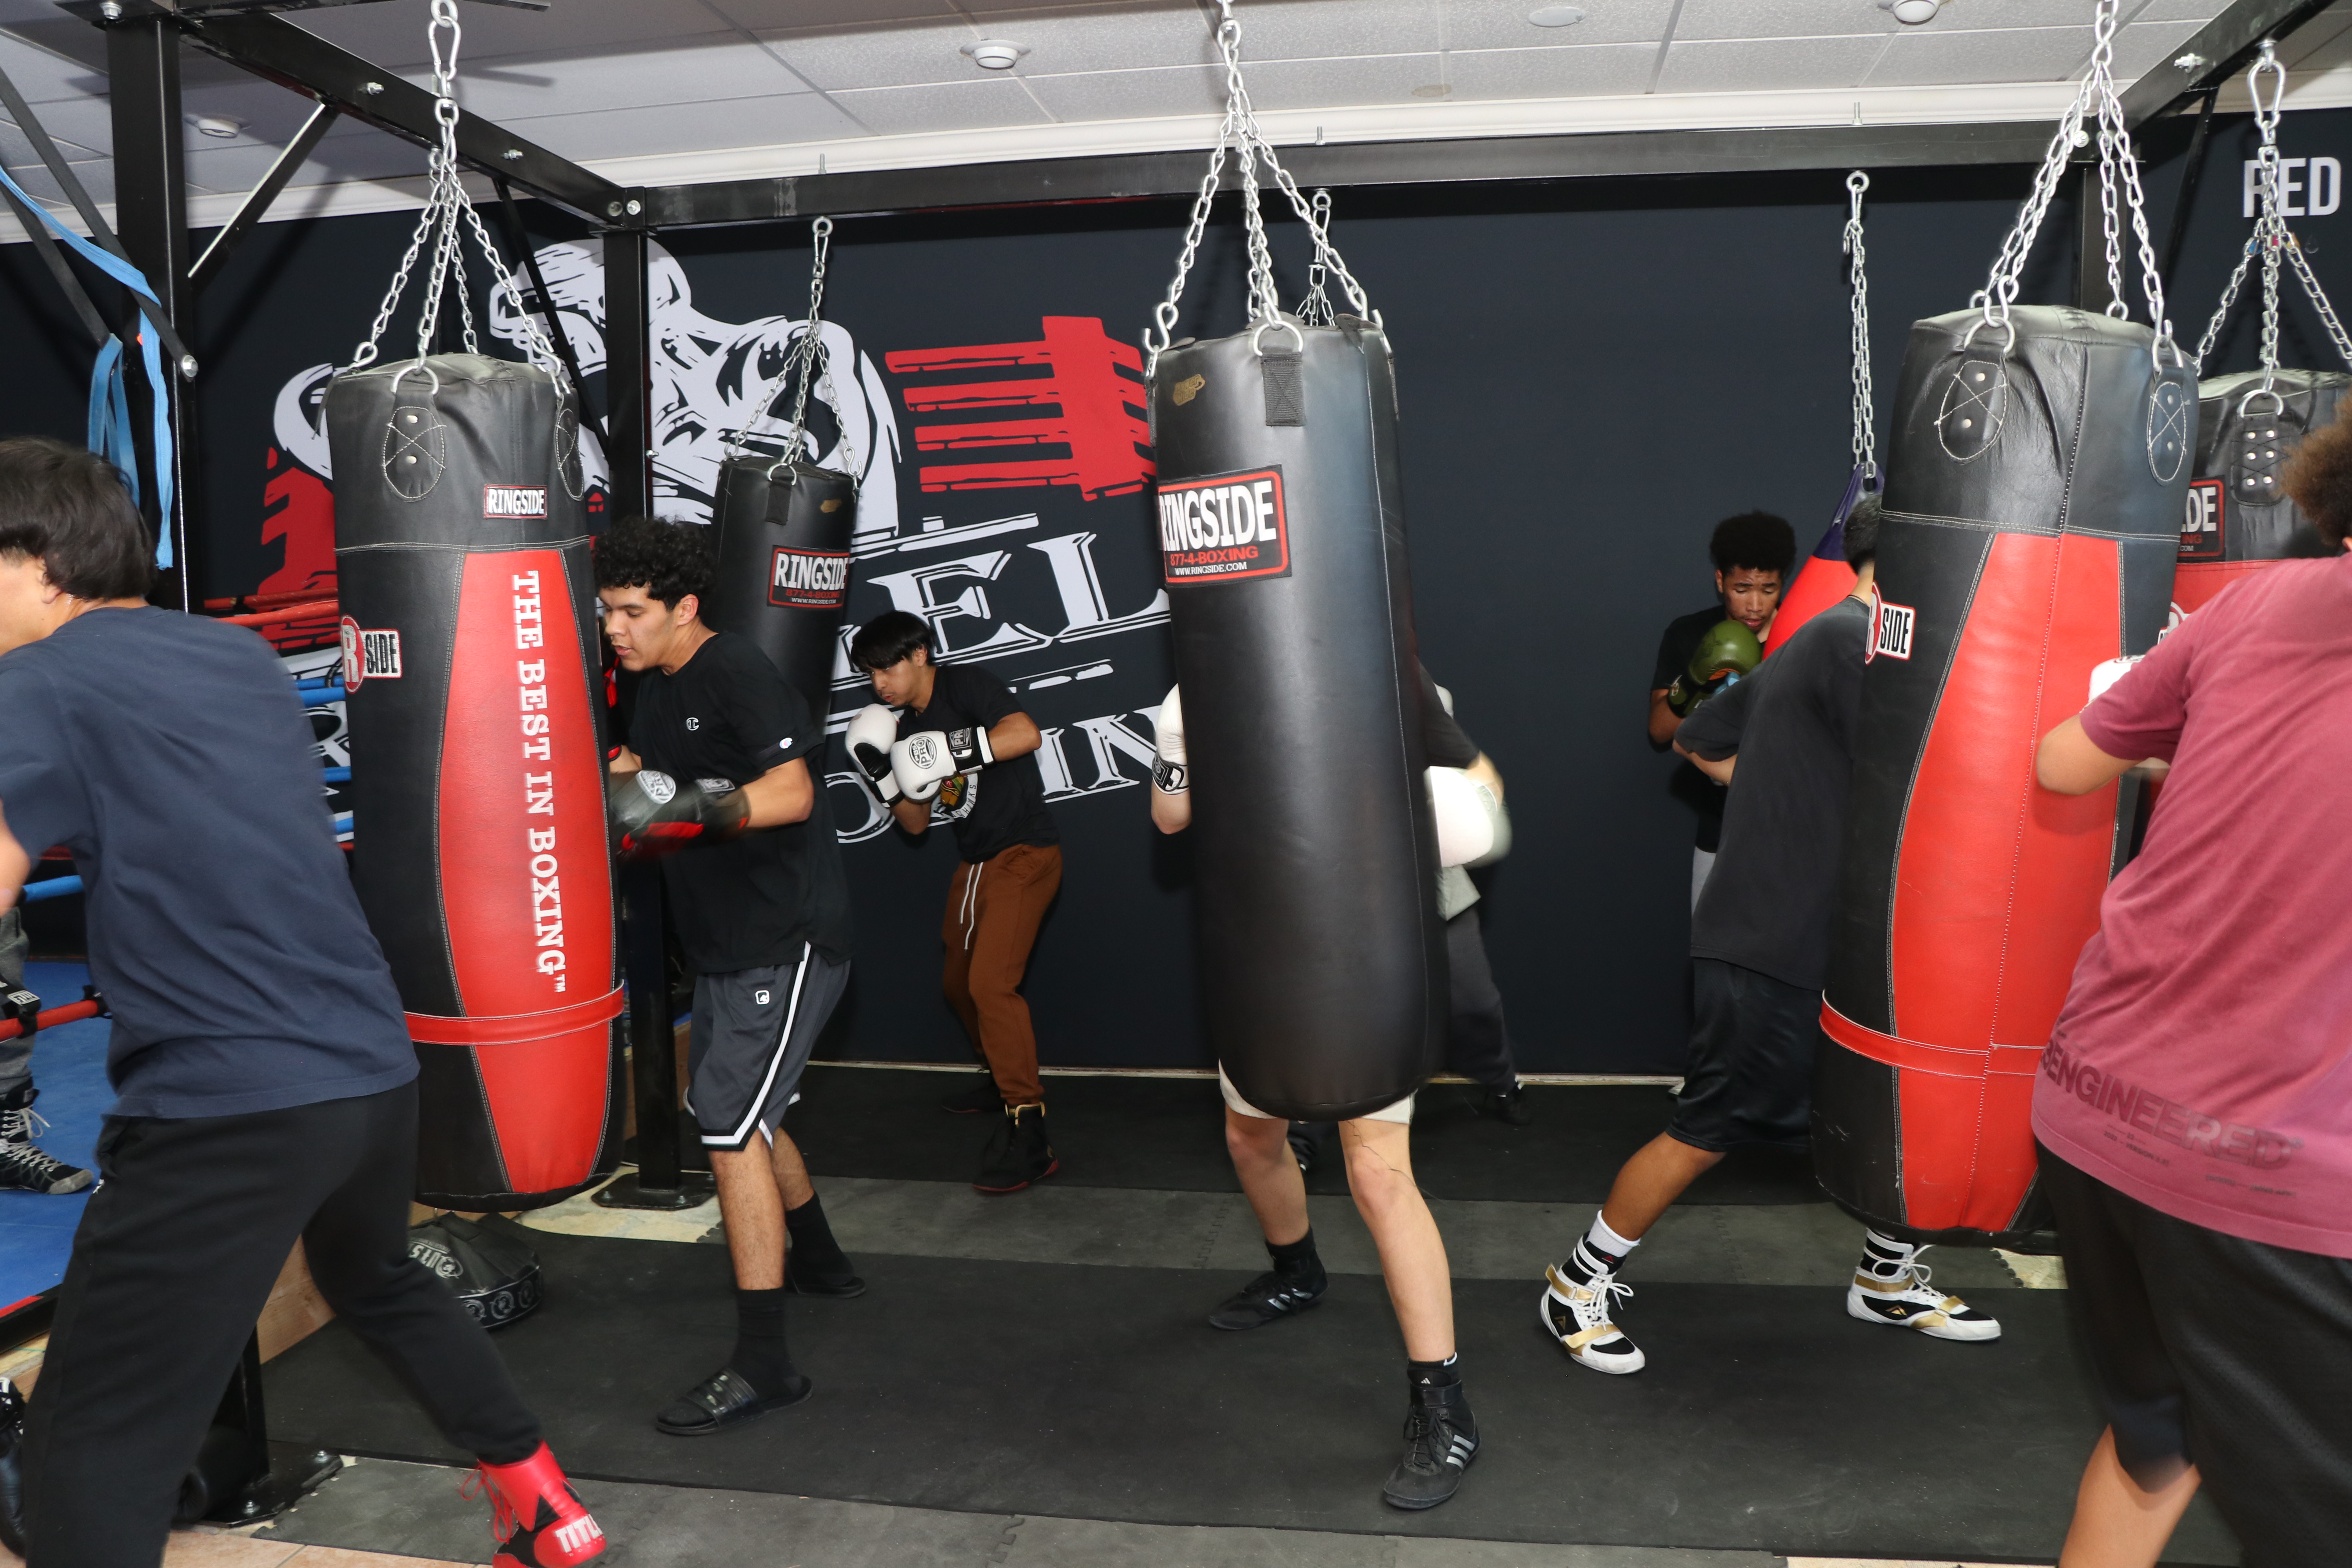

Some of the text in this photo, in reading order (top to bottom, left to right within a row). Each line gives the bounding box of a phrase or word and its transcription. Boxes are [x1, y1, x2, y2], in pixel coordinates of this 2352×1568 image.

[2243, 157, 2341, 218] RED
[488, 489, 544, 514] RINGSIDE
[1159, 480, 1277, 552] RINGSIDE
[775, 553, 849, 590] RINGSIDE
[1170, 545, 1259, 566] 877-4-BOXING
[1174, 562, 1247, 575] WWW.RINGSIDE.COM
[513, 570, 544, 649] THE
[786, 590, 840, 599] 877-4-BOXING
[1880, 608, 1910, 654] SIDE
[365, 634, 398, 673] SIDE
[518, 659, 550, 760] BEST
[524, 771, 554, 816] IN
